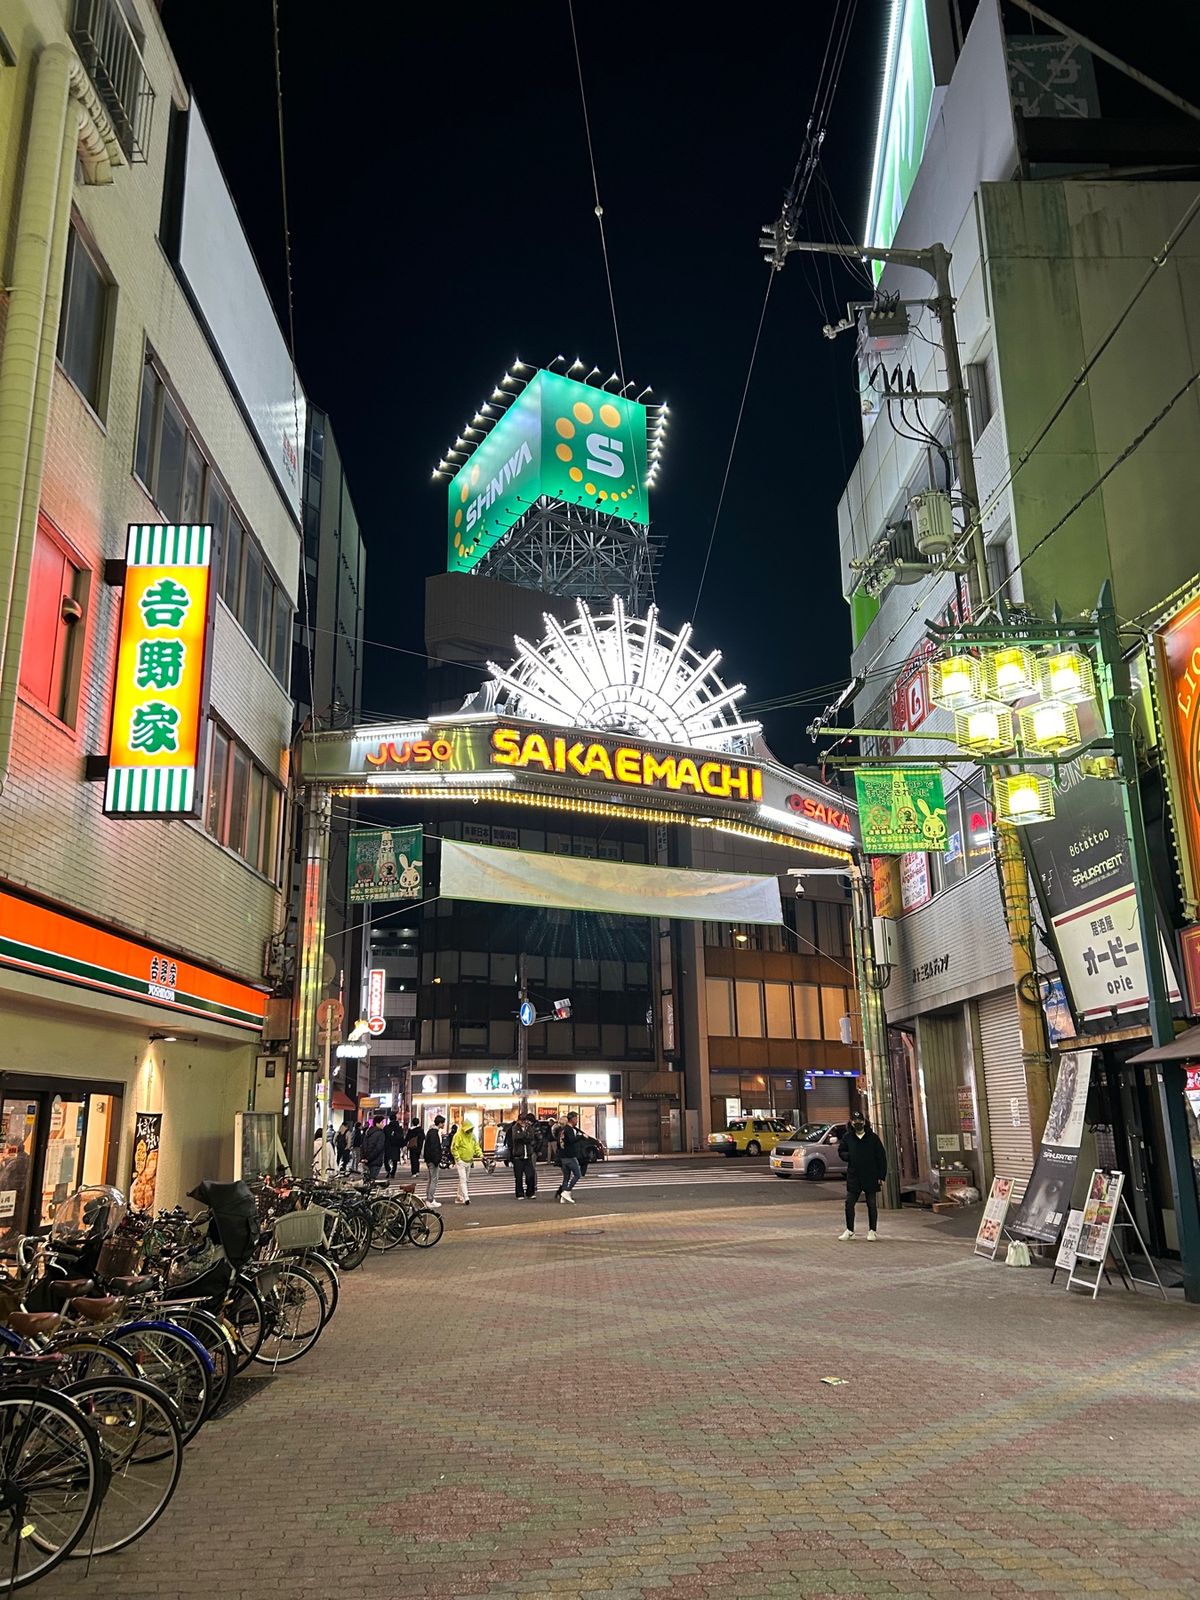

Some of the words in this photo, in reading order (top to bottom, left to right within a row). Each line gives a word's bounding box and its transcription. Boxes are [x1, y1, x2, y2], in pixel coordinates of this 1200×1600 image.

[586, 433, 624, 479] S
[131, 579, 190, 753] 吉野家
[366, 739, 452, 767] JUSO
[491, 728, 763, 801] SAKAEMACHI
[785, 793, 852, 833] OSAKA
[1070, 829, 1110, 857] 86tattoo
[1072, 852, 1123, 887] SAKURAMENT
[1090, 914, 1115, 937] 居酒屋
[1082, 935, 1140, 976] オーピー
[1107, 974, 1134, 995] opie
